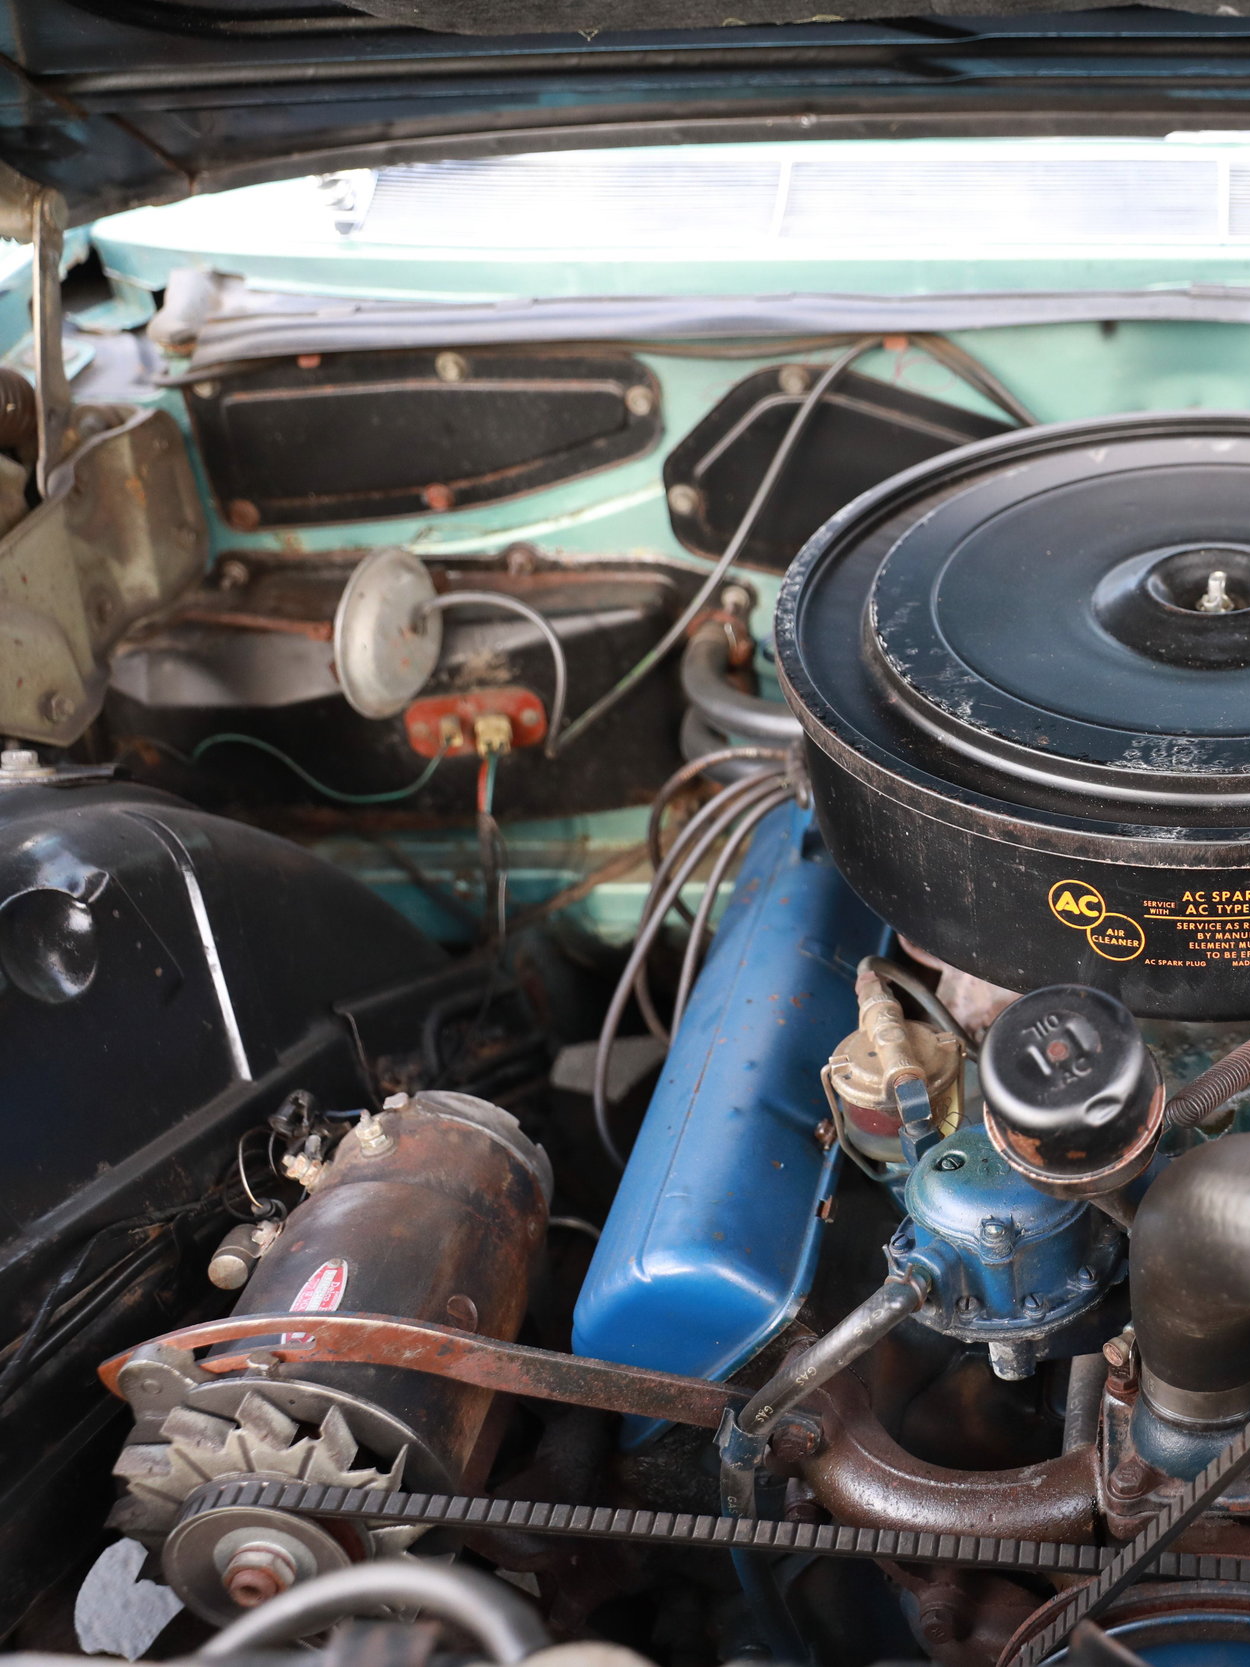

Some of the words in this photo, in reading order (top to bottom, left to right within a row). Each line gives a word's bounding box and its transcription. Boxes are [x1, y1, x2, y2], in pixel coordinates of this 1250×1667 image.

[1182, 891, 1206, 902] AC
[1055, 891, 1100, 917] AC
[1143, 901, 1176, 909] SERVICE
[1185, 904, 1209, 915] AC
[1217, 902, 1250, 914] TYPE
[1149, 907, 1169, 915] WITH
[1176, 920, 1223, 930] SERVICE
[1225, 920, 1240, 929] AS
[1106, 928, 1125, 937] AIR
[1197, 932, 1211, 940] BY
[1092, 935, 1140, 948] CLEANER
[1189, 940, 1236, 950] ELEMENT
[1206, 951, 1221, 959] TO
[1224, 950, 1238, 958] BE
[1184, 959, 1206, 967] PLUG
[1022, 1015, 1059, 1040] OIL
[853, 1308, 884, 1336] GAS
[796, 1366, 816, 1386] GAS
[755, 1405, 774, 1423] GAS
[727, 1495, 738, 1515] GAS
